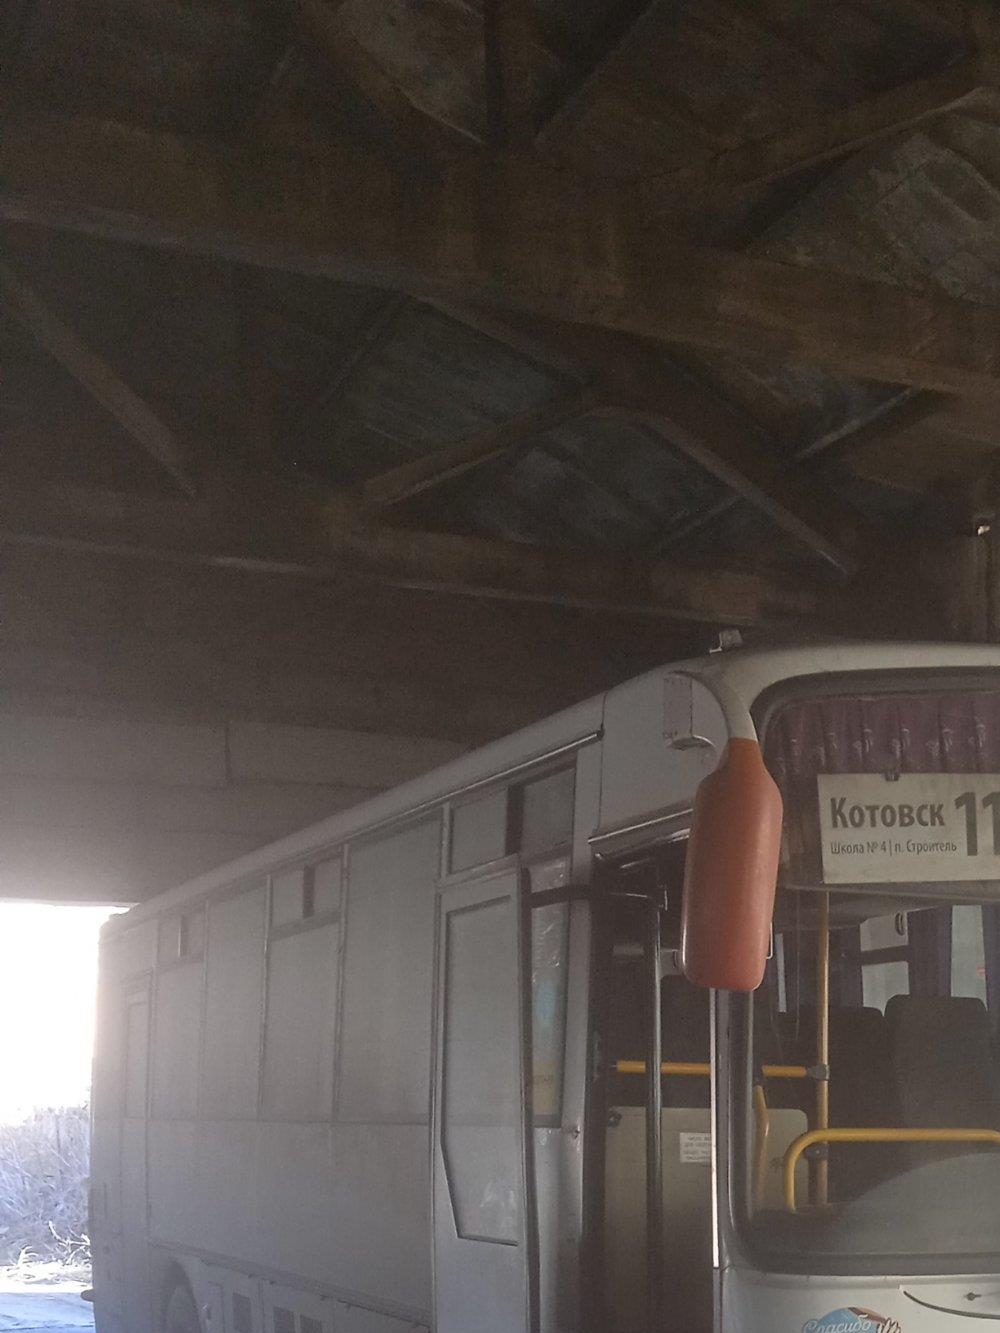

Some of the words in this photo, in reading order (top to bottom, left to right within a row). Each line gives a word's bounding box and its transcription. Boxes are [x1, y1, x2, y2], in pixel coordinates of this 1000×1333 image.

[830, 797, 946, 828] Котовск
[831, 841, 865, 855] Школа
[906, 839, 957, 854] Строитель
